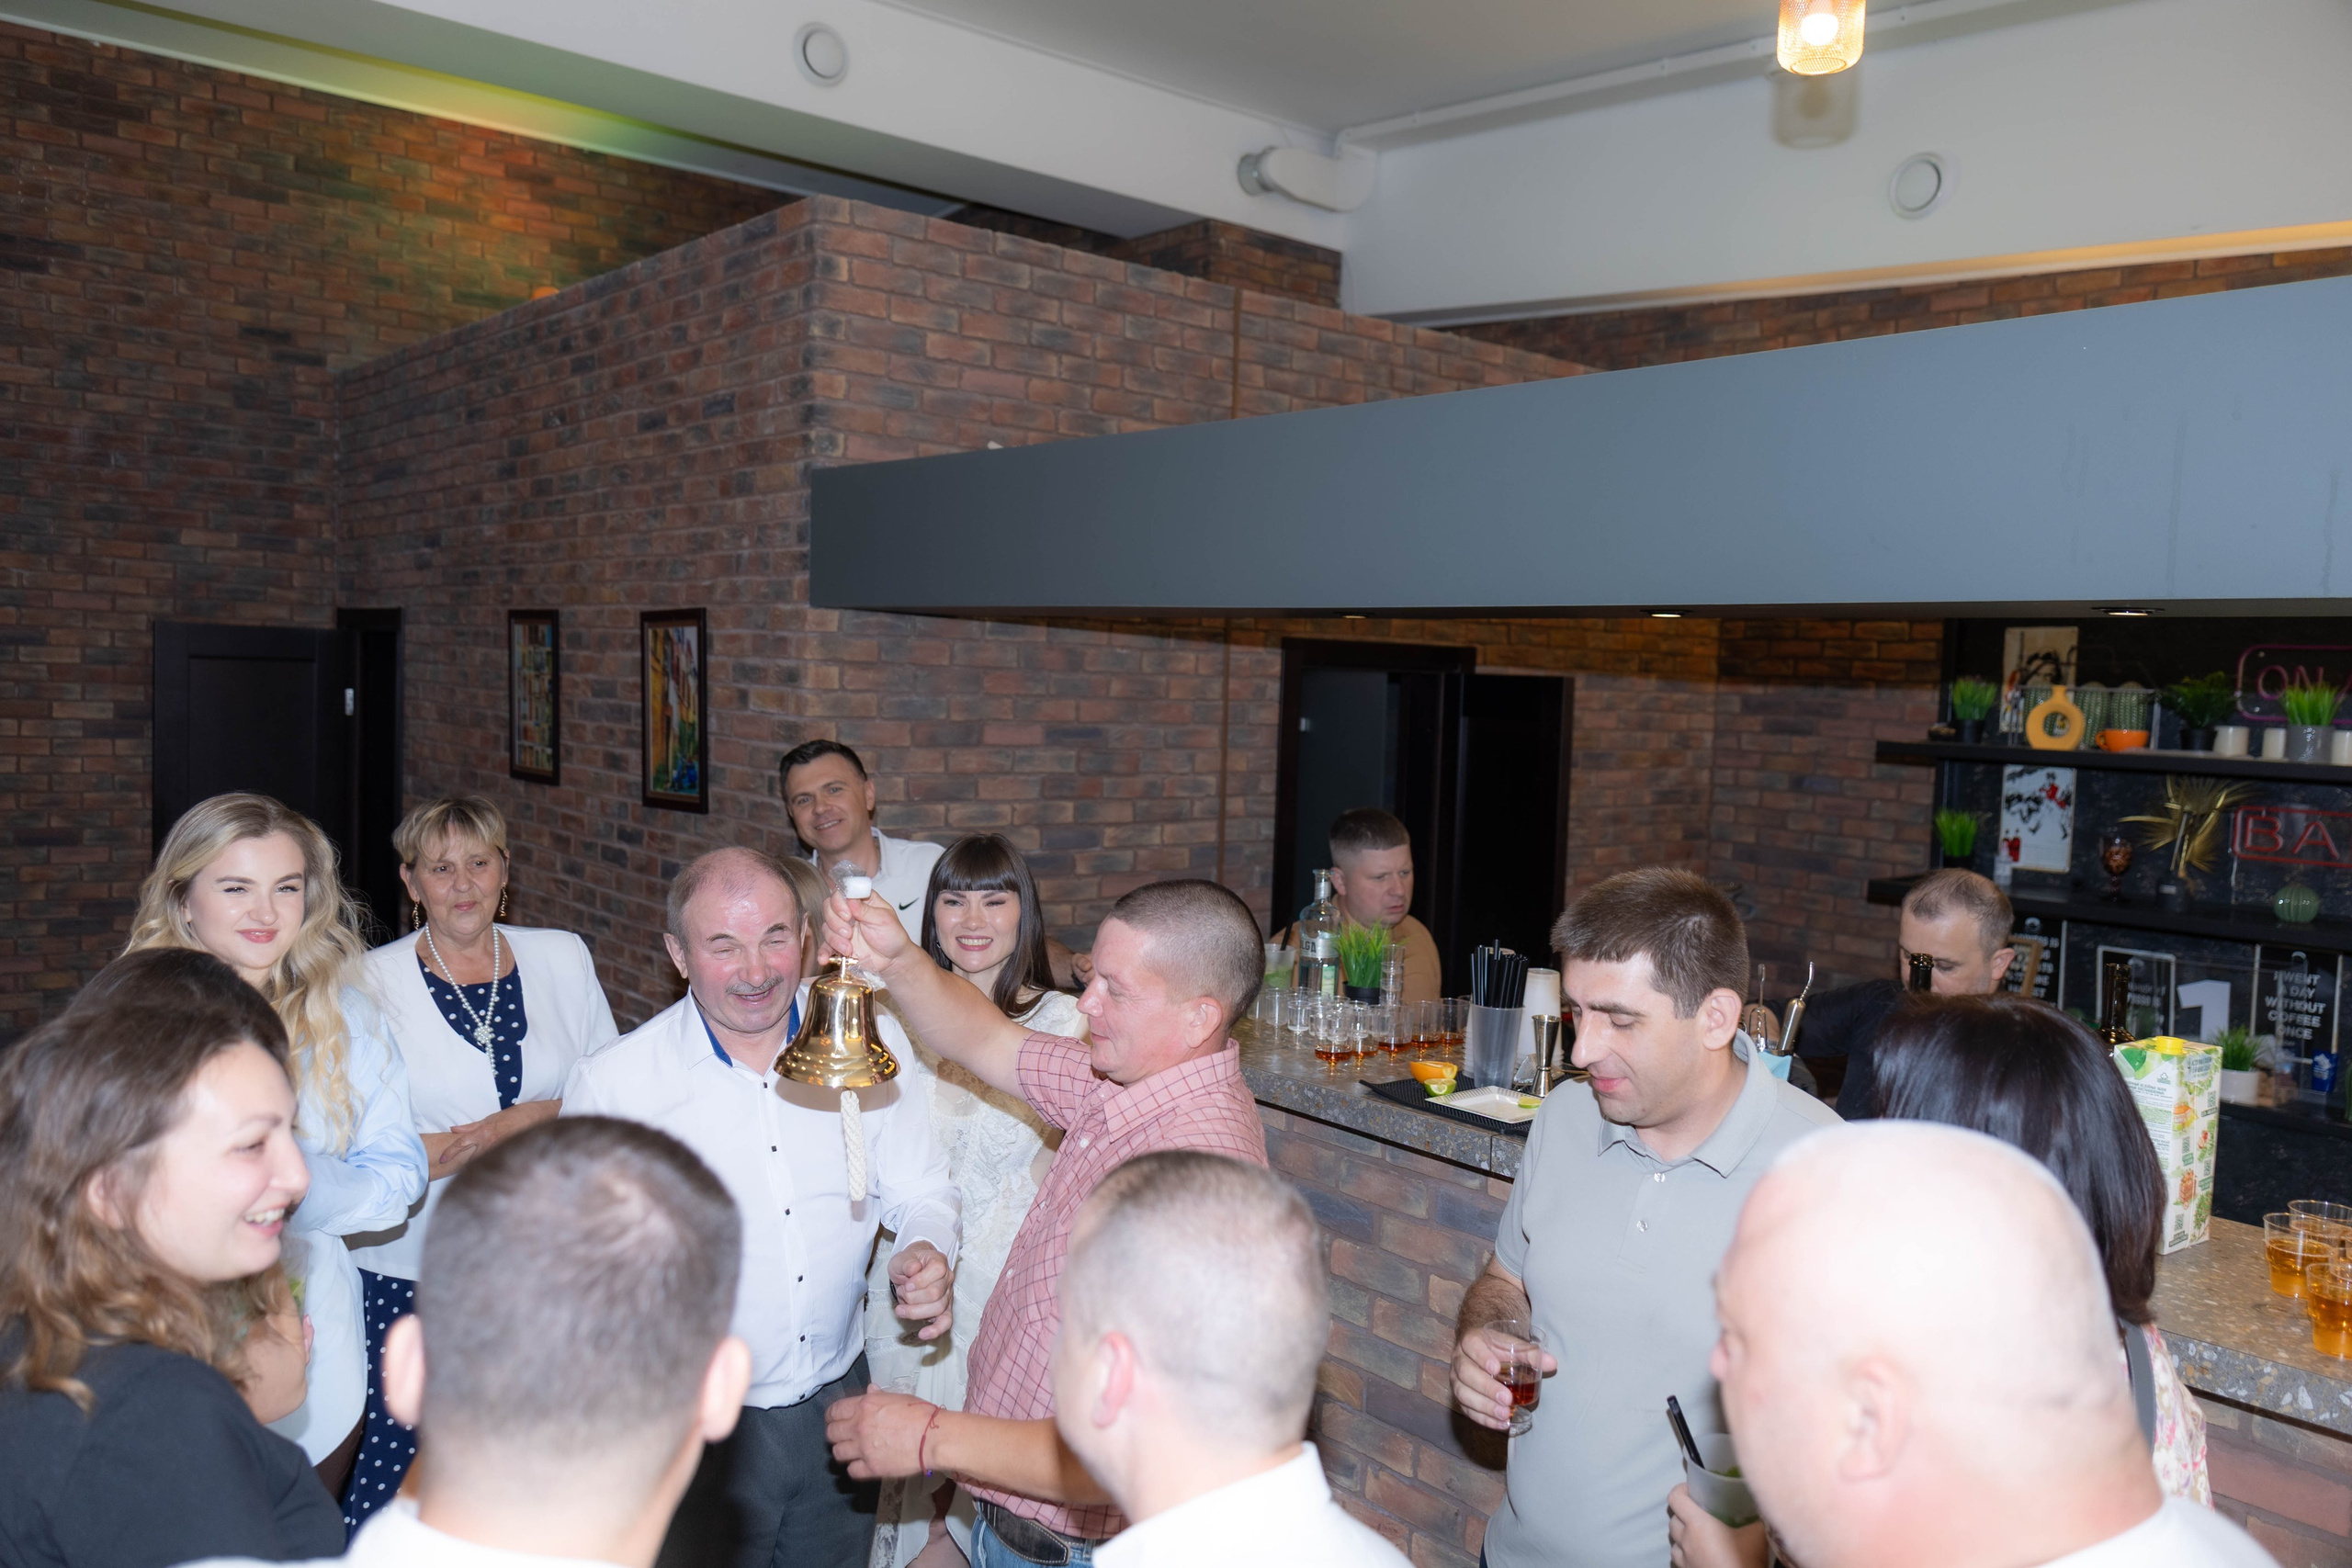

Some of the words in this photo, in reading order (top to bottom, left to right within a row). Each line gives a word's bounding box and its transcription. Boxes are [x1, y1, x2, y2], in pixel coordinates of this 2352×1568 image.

[2244, 815, 2352, 861] BA
[2283, 971, 2321, 987] WENT
[2290, 986, 2315, 998] DAY
[2177, 979, 2231, 1042] 1
[2264, 996, 2326, 1015] WITHOUT
[2267, 1010, 2321, 1028] COFFEE
[2277, 1023, 2312, 1041] ONCE
